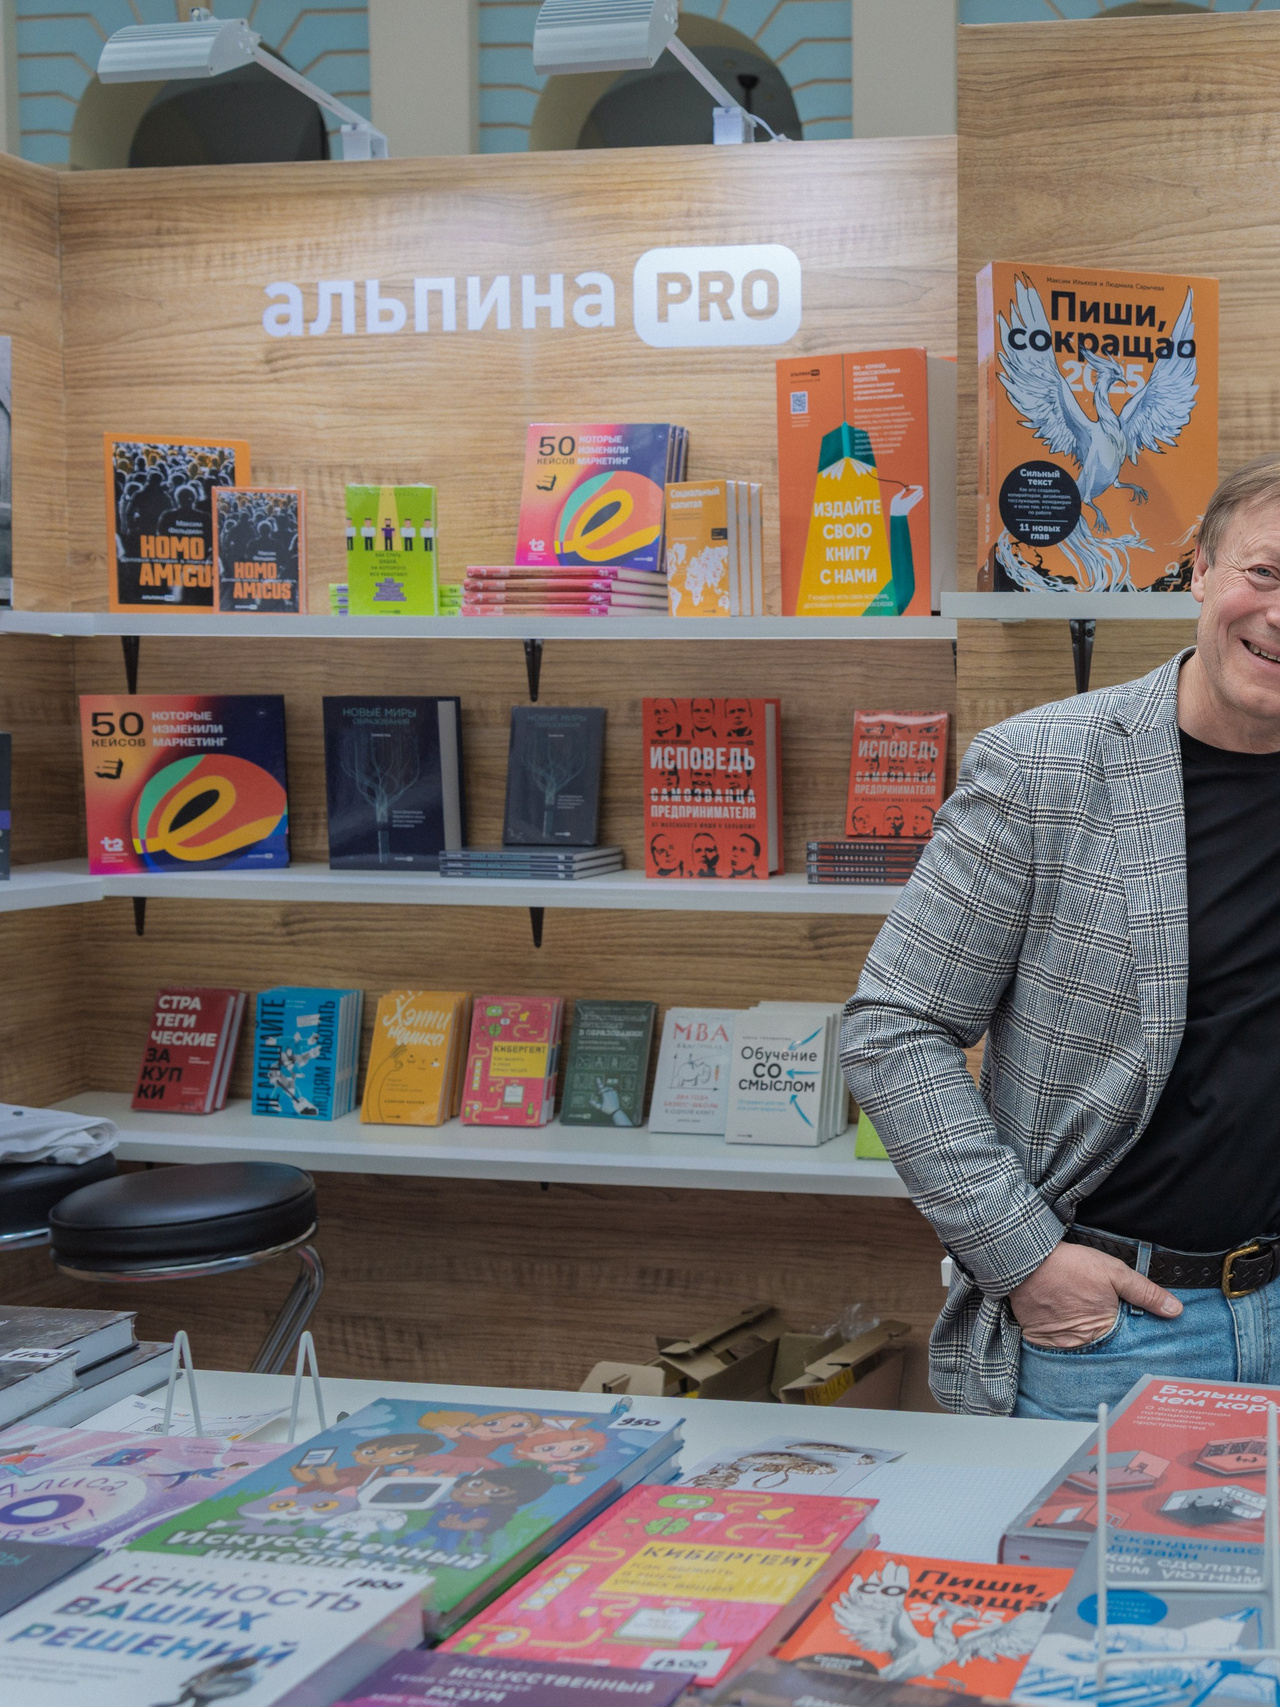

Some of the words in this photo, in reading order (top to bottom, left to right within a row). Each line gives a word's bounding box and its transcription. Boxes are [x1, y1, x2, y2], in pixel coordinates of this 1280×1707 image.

[1046, 276, 1071, 285] Максим
[1073, 279, 1098, 287] Ильяхов
[1105, 281, 1134, 290] Людмила
[1135, 284, 1165, 292] Сарычева
[656, 268, 780, 323] PRO
[262, 271, 616, 338] альпина
[1051, 290, 1167, 332] Пиши,
[538, 436, 576, 456] 50
[579, 435, 623, 443] КОТОРЫЕ
[577, 445, 629, 454] ИЗМЕНИЛИ
[537, 456, 575, 465] КЕЙСОВ
[577, 457, 631, 465] МАРКЕТИНГ
[1020, 469, 1060, 478] Сильный
[814, 496, 881, 518] ИЗДАЙТЕ
[823, 523, 872, 539] СВОЮ
[1019, 523, 1030, 531] 11
[140, 535, 205, 560] HOMO
[826, 545, 871, 561] КНИГУ
[139, 563, 214, 588] AMICU
[234, 562, 277, 579] HOMO
[820, 569, 831, 584] С
[834, 568, 877, 584] НАМИ
[233, 582, 292, 600] AMICUS
[151, 711, 212, 721] КОТОРЫЕ
[343, 708, 382, 717] НОВЫЕ
[384, 708, 416, 718] МИРЫ
[91, 712, 144, 737] 50
[152, 724, 223, 734] ИЗМЕНИЛИ
[91, 738, 146, 747] КЕЙСОВ
[152, 737, 228, 747] МАРКЕТИНГ
[858, 740, 939, 760] ИСПОВЕДЬ
[650, 746, 755, 773] ИСПОВЕДЬ
[855, 771, 937, 783] САМОЗВАНЦА
[650, 787, 756, 804] САМОЗВАНЦА
[855, 784, 936, 795] ПРЕДПРИНИМАТЕЛЯ
[650, 805, 756, 819] ПРЕДПРИНИМАТЕЛЯ
[101, 836, 124, 852] t2
[158, 995, 202, 1010] СТРА
[155, 1012, 197, 1028] ТЕГИ
[151, 1030, 218, 1047] ЧЕСКИЕ
[673, 1022, 729, 1042] MBA
[145, 1048, 170, 1063] ЗА
[741, 1046, 818, 1063] Обучение
[141, 1065, 183, 1082] КУП
[137, 1083, 165, 1100] КИ
[738, 1078, 815, 1093] смыслом
[256, 1092, 280, 1114] НЕ
[1152, 1395, 1205, 1407] чем
[1159, 1385, 1275, 1405] Больше,
[167, 1531, 488, 1569] Искусственный
[643, 1547, 820, 1568] КИБЕРГЕЙТ
[1107, 1545, 1199, 1560] дизайн
[1104, 1553, 1147, 1565] как
[1157, 1559, 1259, 1576] сделать
[916, 1570, 1047, 1597] Пиши,
[1161, 1569, 1262, 1584] уютным
[94, 1574, 362, 1612] ЦЕННОСТЬ
[857, 1582, 1058, 1613] сокраща
[53, 1596, 272, 1631] ВАШИХ
[5, 1623, 299, 1668] РЕШЕНИЙ
[449, 1666, 655, 1694] ИСКУССТВЕННЫЙ
[425, 1685, 507, 1702] РАЗУМ
